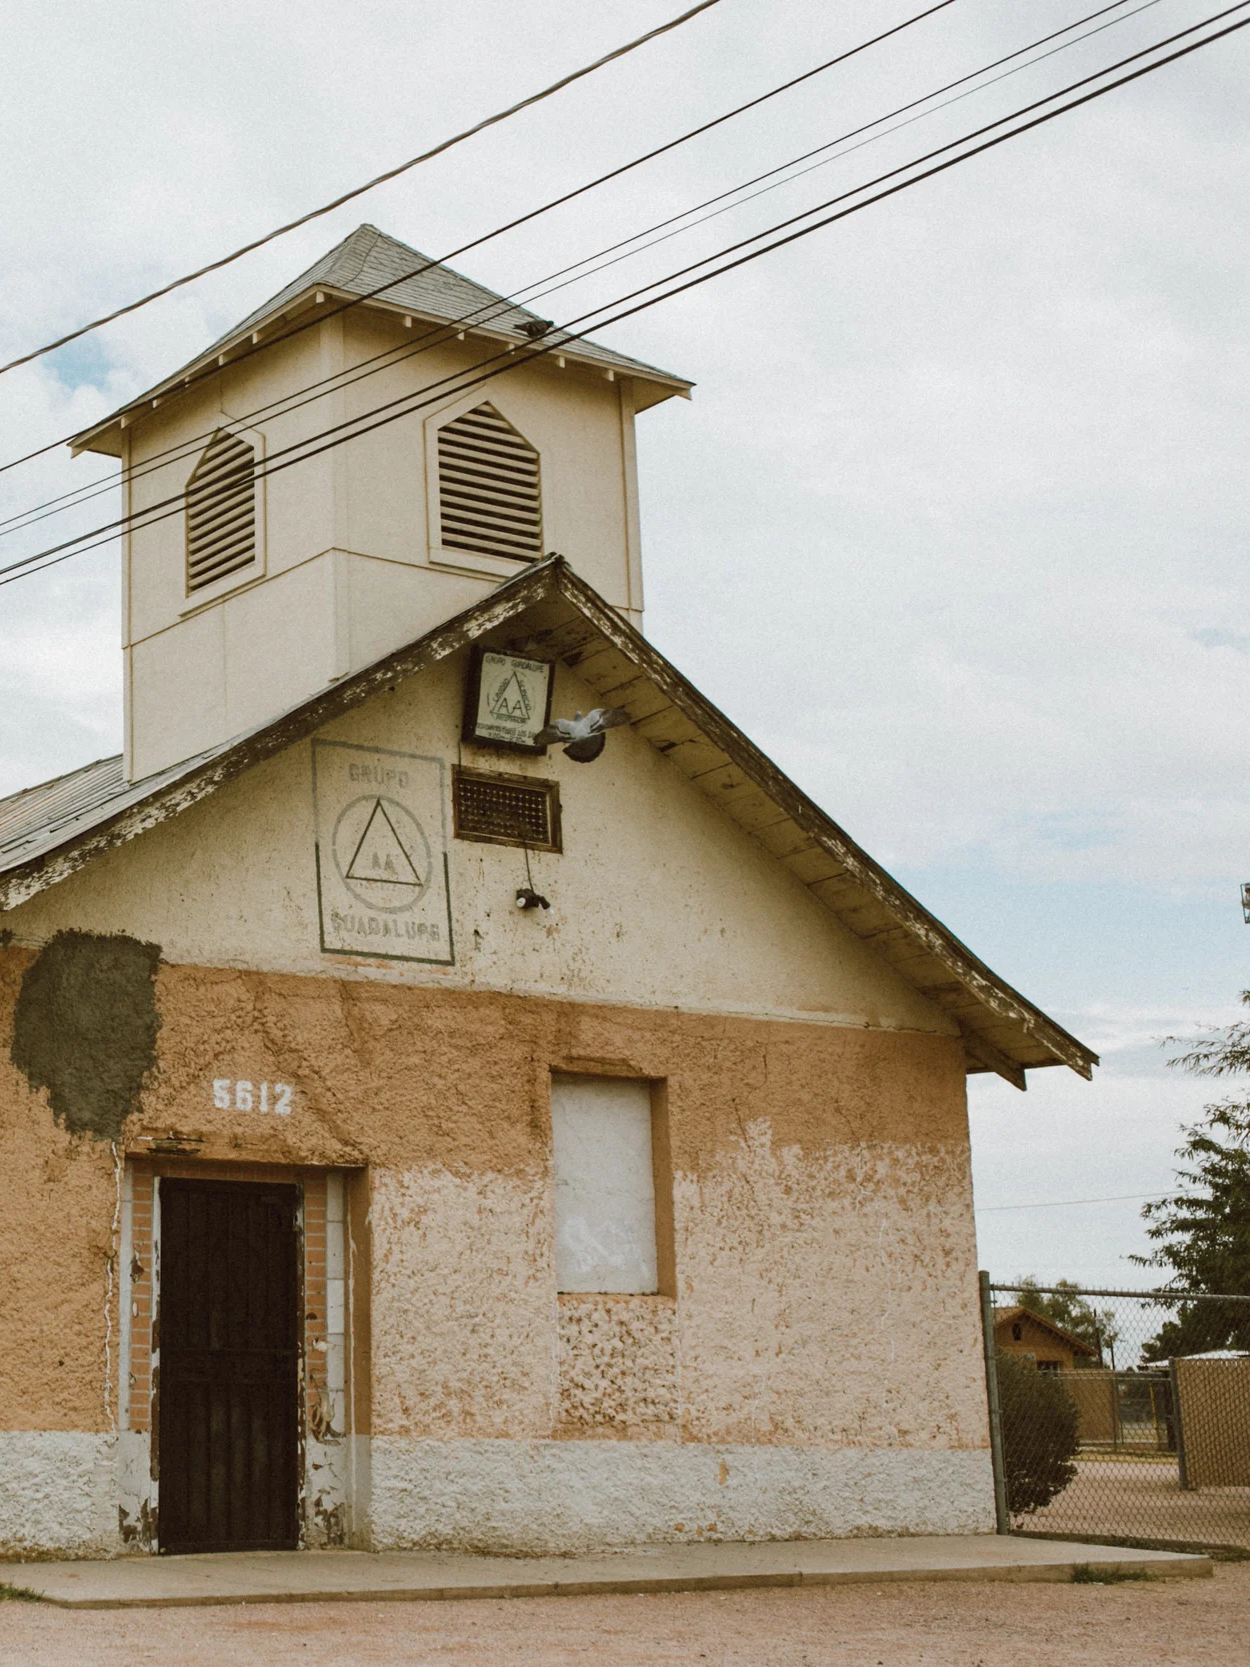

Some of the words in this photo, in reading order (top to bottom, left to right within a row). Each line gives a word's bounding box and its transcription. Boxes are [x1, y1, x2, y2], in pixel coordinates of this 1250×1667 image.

[485, 655, 506, 666] GRUPO
[510, 659, 545, 673] GUADALUPE
[497, 697, 526, 717] AA
[348, 763, 409, 788] GRUPO
[212, 1078, 293, 1116] 5612
